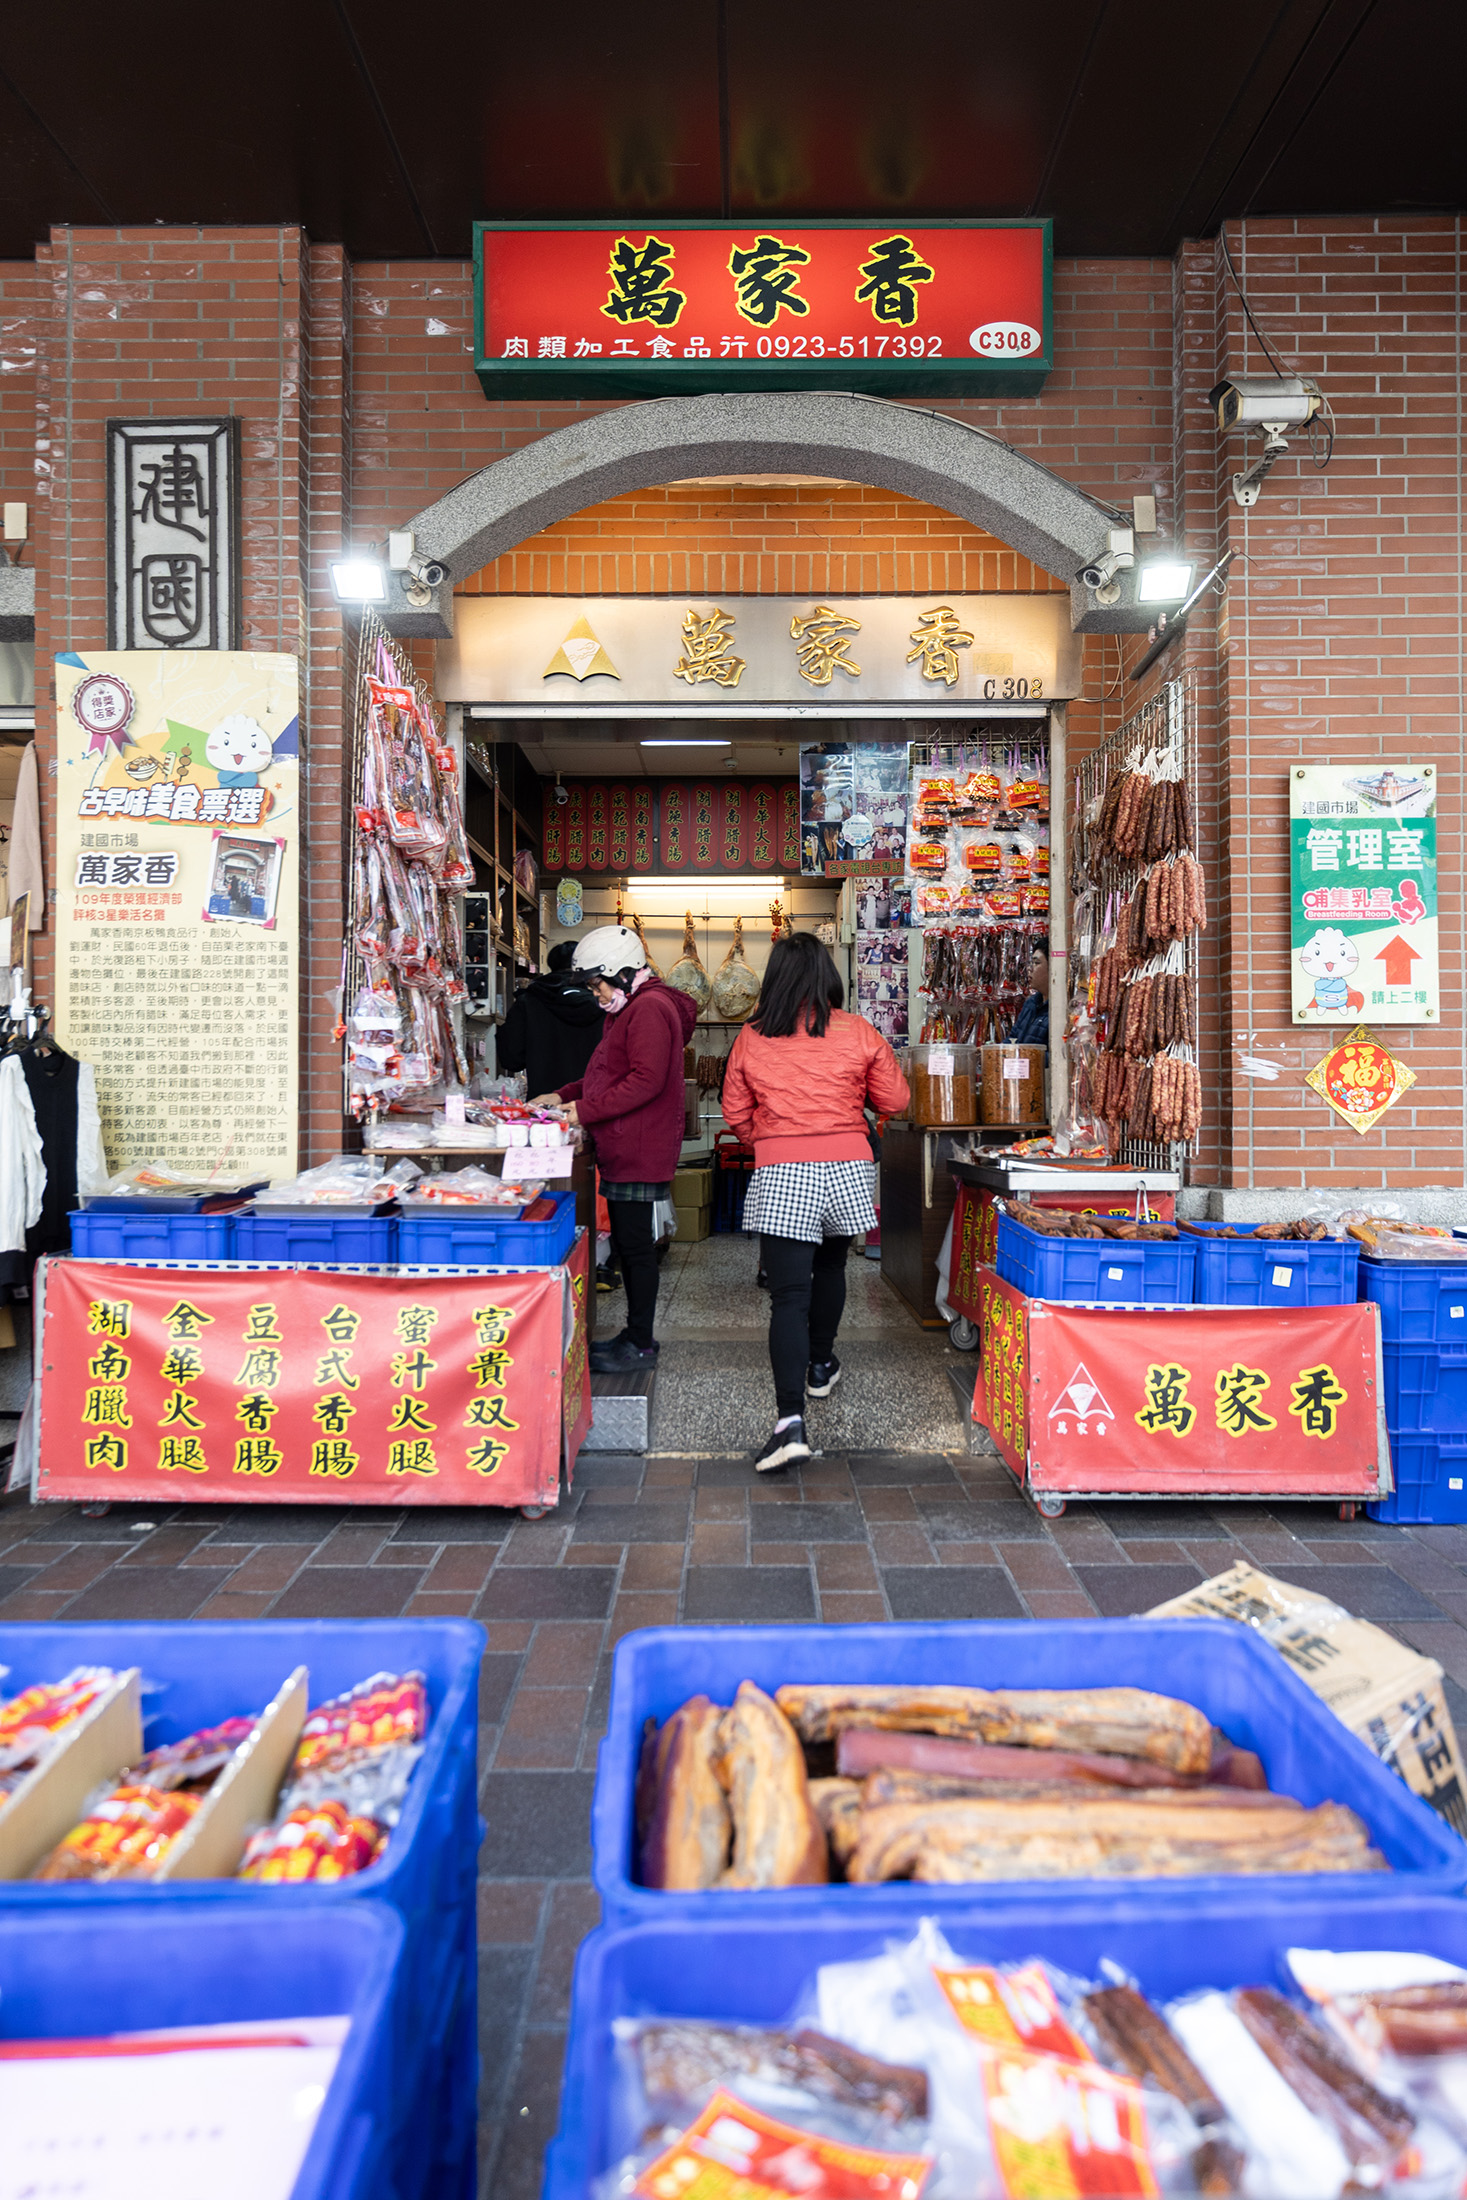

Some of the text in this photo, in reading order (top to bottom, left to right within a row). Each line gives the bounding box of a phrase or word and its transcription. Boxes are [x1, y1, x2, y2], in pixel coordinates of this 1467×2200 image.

[599, 234, 935, 329] 萬家香
[501, 335, 942, 359] 肉類加工食品行 0923-517392
[978, 330, 1033, 351] C308
[138, 446, 208, 643] 建國
[672, 605, 974, 688] 萬家香
[91, 695, 115, 708] 得獎
[94, 707, 116, 719] 店家
[78, 782, 265, 824] 古早味美食票選
[1302, 800, 1359, 815] 建國市場
[80, 833, 139, 847] 建國市場
[666, 790, 683, 862] 麻辣香腸
[753, 790, 773, 862] 金華火腿
[783, 790, 800, 862] 蜜汁火腿
[78, 855, 175, 884] 萬家香
[829, 860, 904, 875] 各家電視台專訪
[1306, 828, 1424, 871] 管理室
[75, 892, 182, 905] 109年度榮獲經濟部
[1304, 889, 1392, 908] 哺集乳室
[1371, 990, 1427, 1005] 請上二樓
[1339, 1046, 1381, 1087] 福
[82, 1299, 132, 1471] 湖南臘肉
[157, 1299, 214, 1474] 金華火腿
[233, 1302, 283, 1477] 豆腐香腸
[310, 1302, 360, 1479] 台式香腸
[386, 1305, 439, 1478] 蜜汁火腿
[465, 1305, 519, 1476] 富貴双方
[1134, 1363, 1348, 1440] 萬家香
